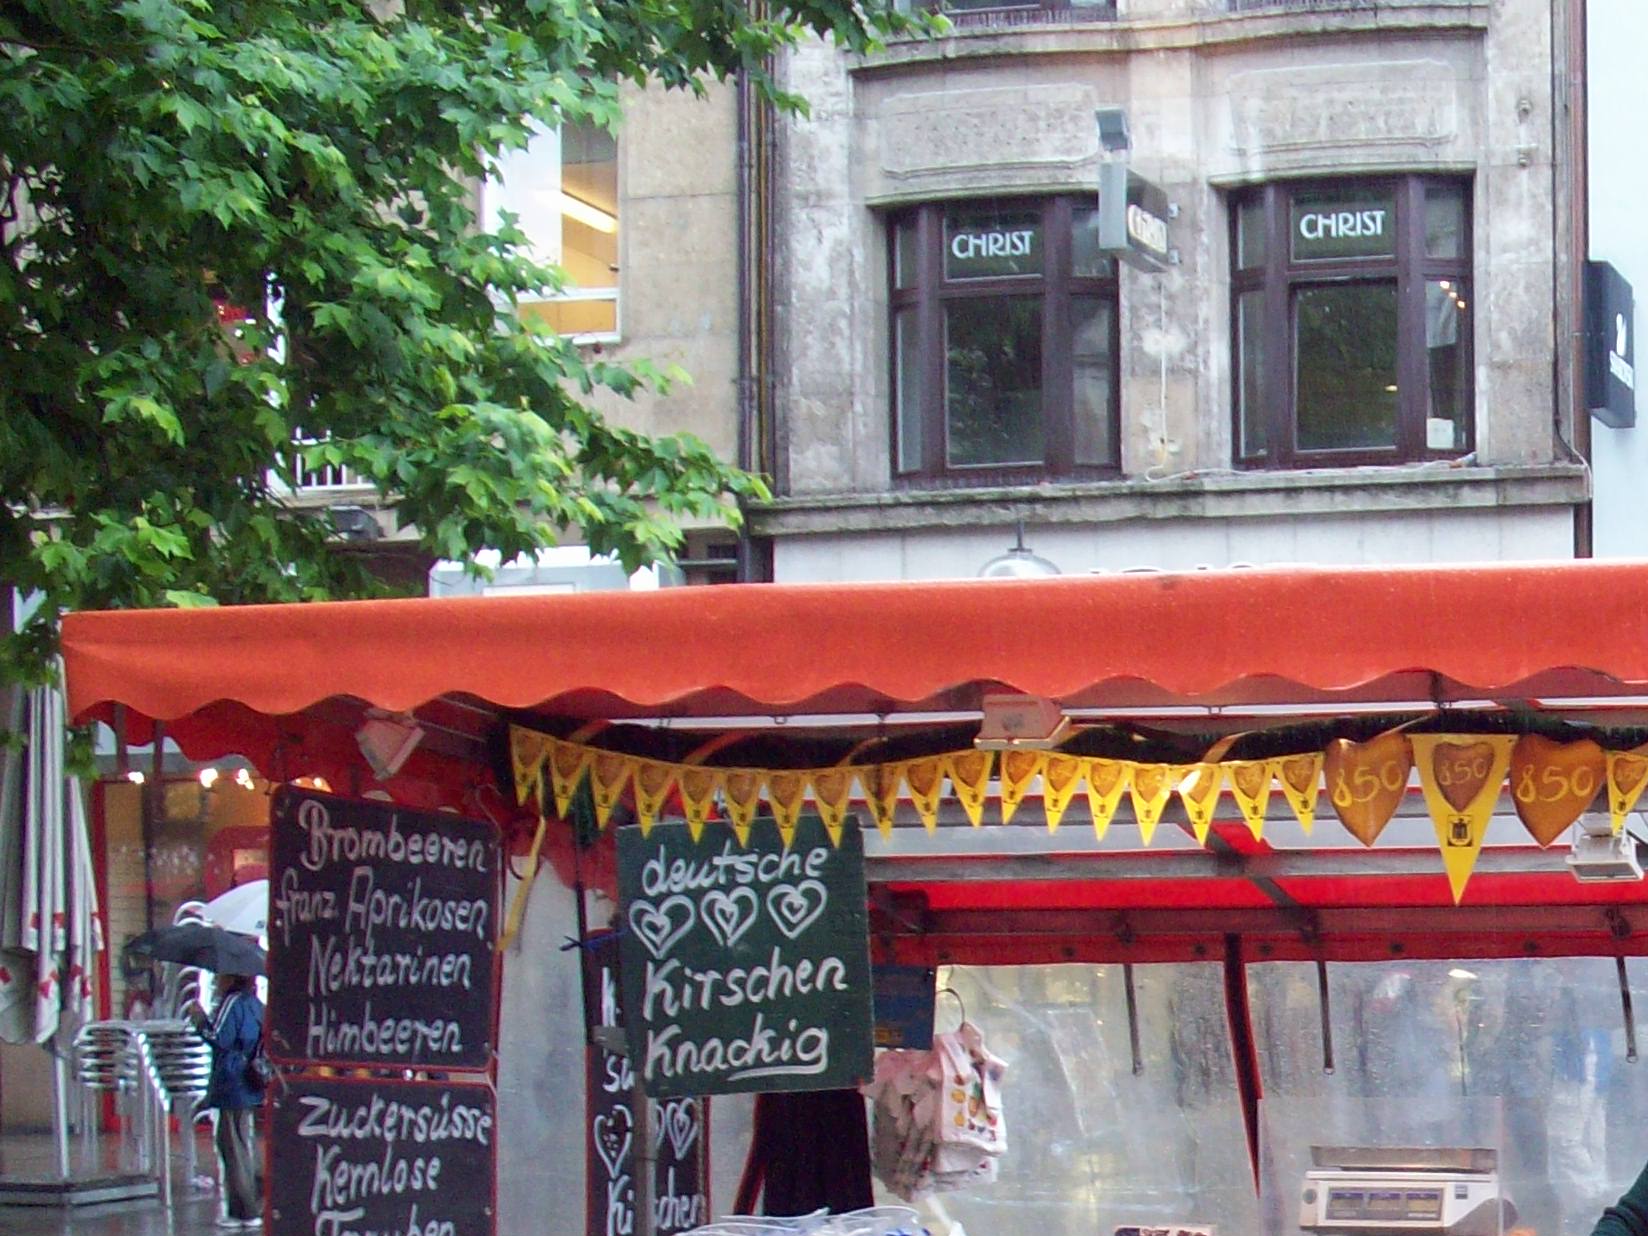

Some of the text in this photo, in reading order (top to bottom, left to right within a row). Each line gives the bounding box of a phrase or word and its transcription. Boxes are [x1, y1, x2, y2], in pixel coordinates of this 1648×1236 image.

[951, 230, 1033, 259] CHRIST
[1300, 210, 1386, 240] CHRIST
[1334, 761, 1402, 807] 850
[1439, 758, 1487, 786] 850
[1517, 764, 1594, 803] 850
[299, 799, 487, 871] Brombeeren
[642, 839, 828, 896] deutsche
[345, 866, 488, 948] Aprikosen
[307, 933, 471, 997] Nektarinen
[643, 946, 848, 1022] Kirschen
[307, 1001, 463, 1055] Himbeeren
[644, 1012, 829, 1082] Knackig
[311, 1143, 441, 1215] Kernlose
